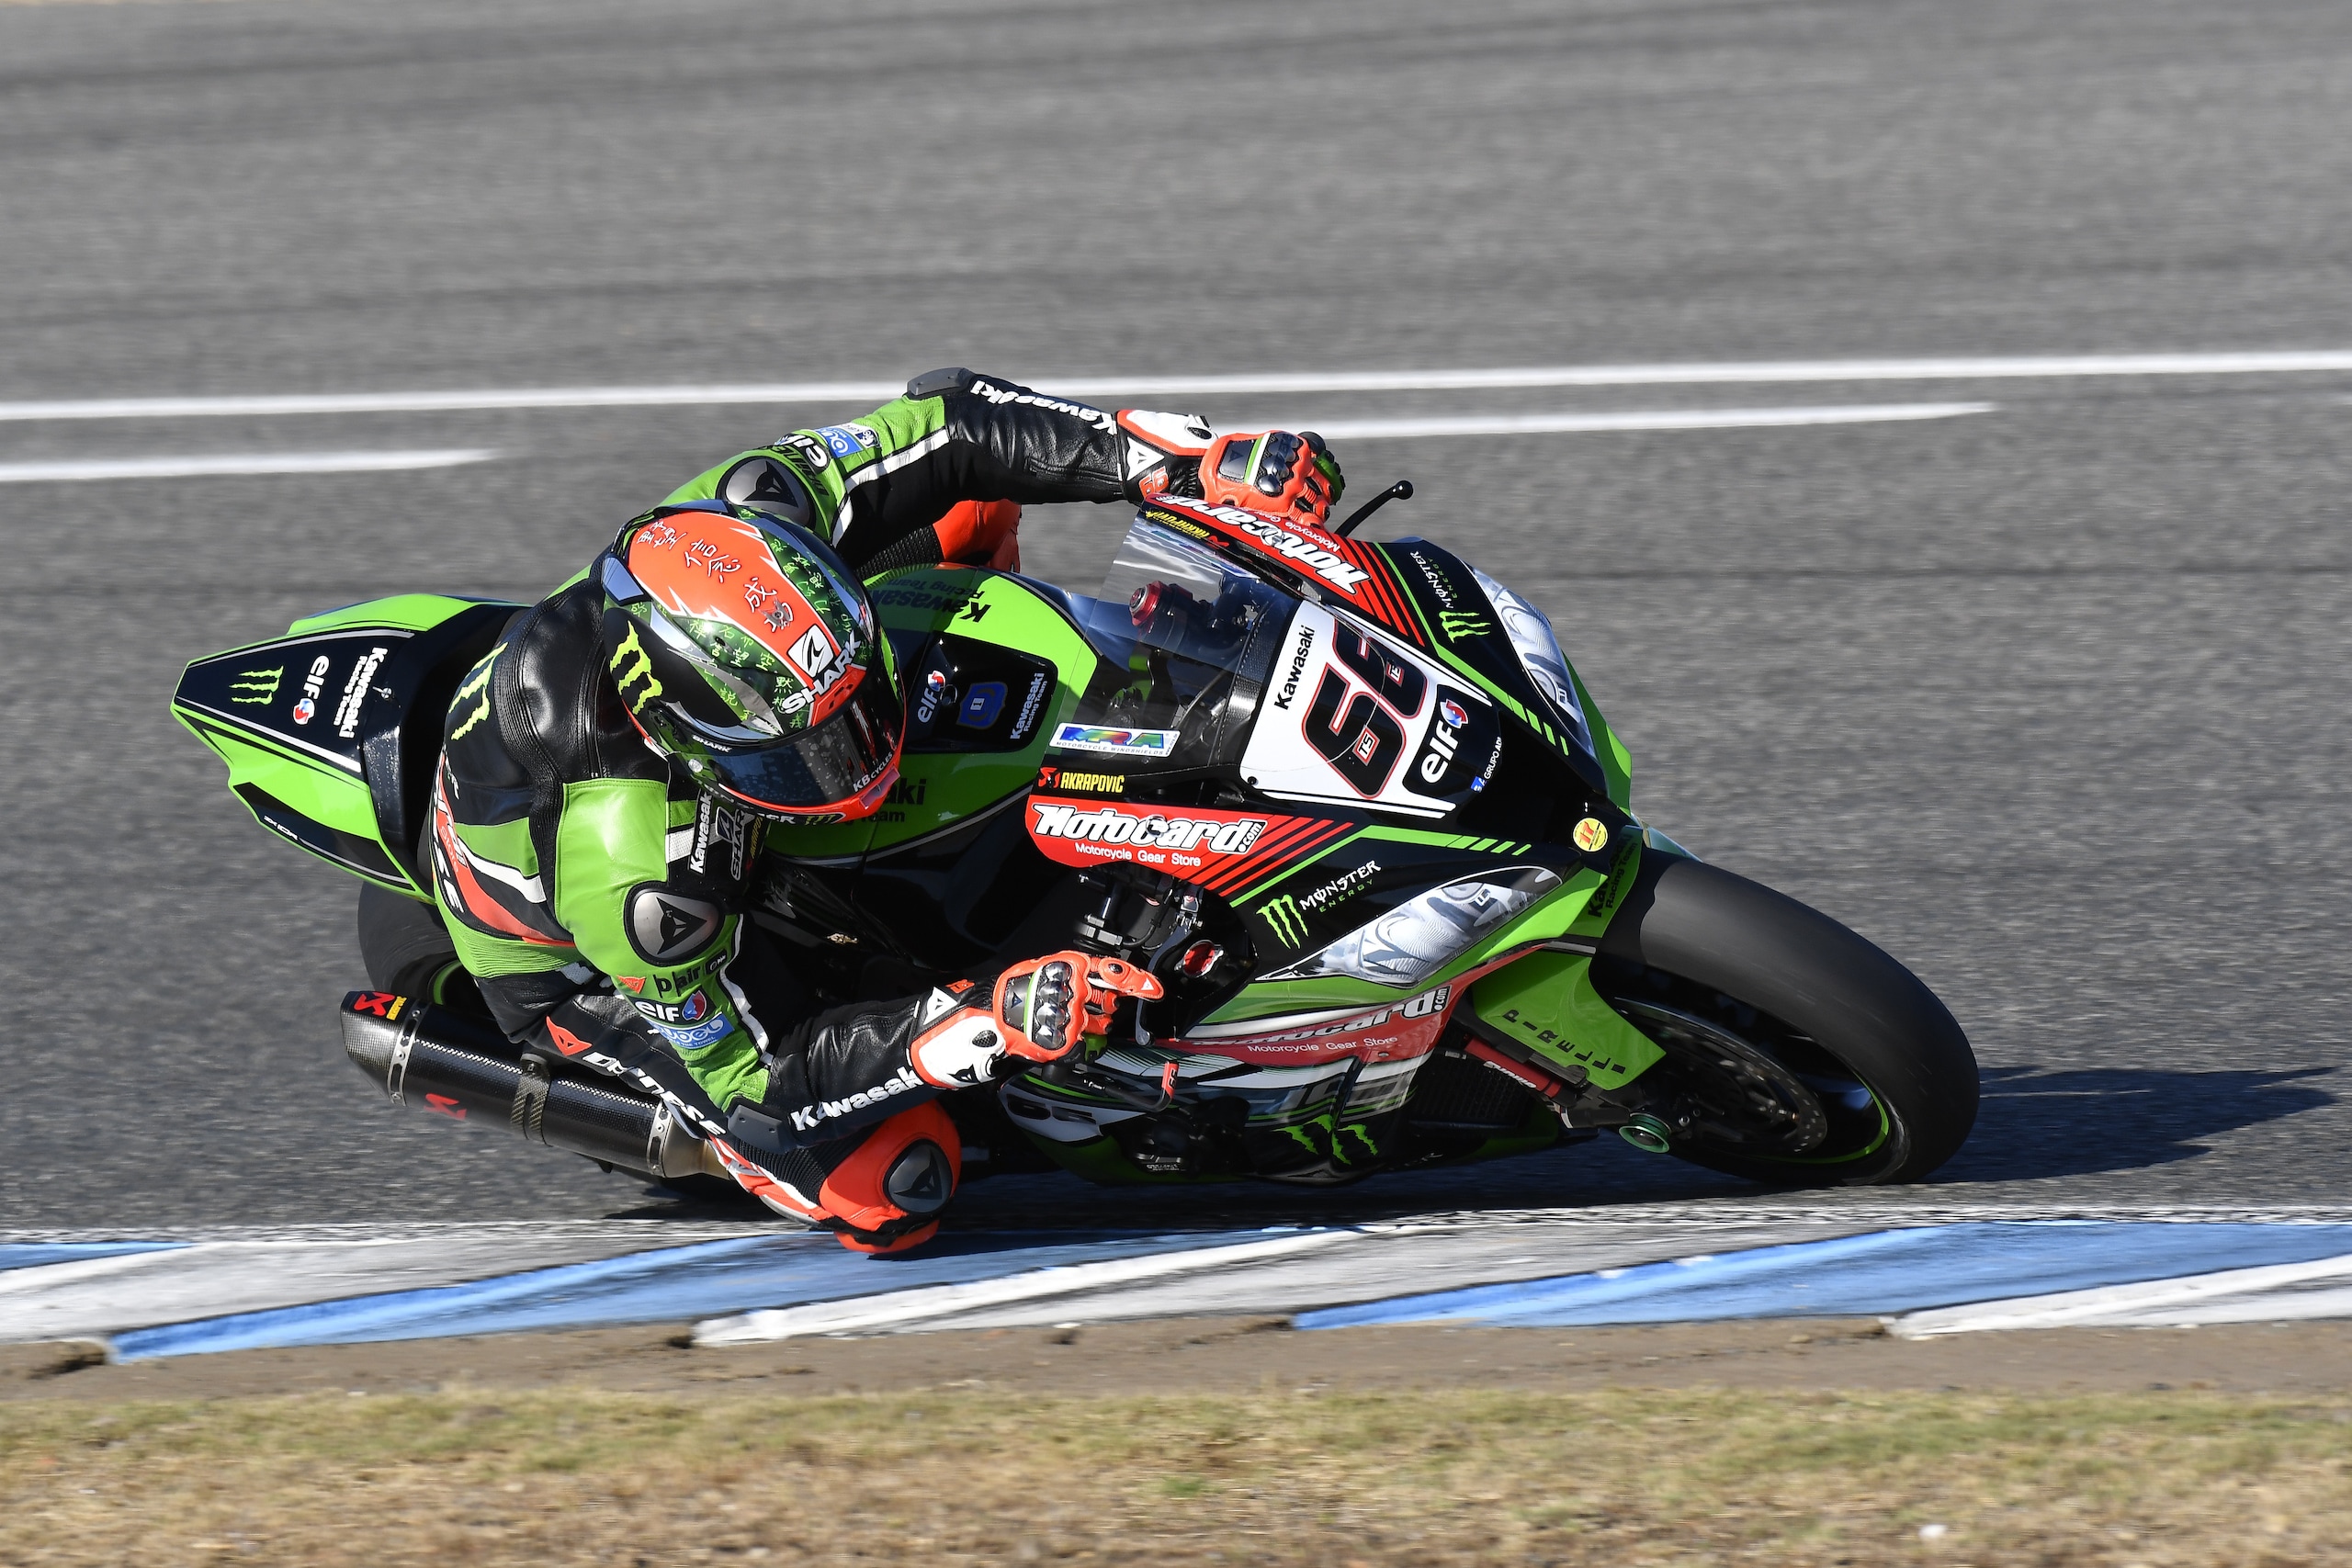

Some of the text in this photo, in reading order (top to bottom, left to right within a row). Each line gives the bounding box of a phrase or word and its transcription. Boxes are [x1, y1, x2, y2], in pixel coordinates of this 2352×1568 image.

[970, 379, 1117, 435] Kawasaki
[870, 590, 992, 624] Kawasak
[302, 655, 331, 700] elf
[781, 629, 863, 715] SHARK
[1273, 624, 1316, 710] Kawasaki
[338, 647, 389, 739] Kawasaki
[917, 687, 939, 724] elf
[1010, 672, 1046, 739] Kawasaki
[1023, 681, 1048, 732] Racing Team
[1301, 616, 1429, 800] 66
[692, 734, 733, 754] SHARK
[1056, 741, 1164, 756] MOTORCYCLE WINDSHIELDS
[1059, 726, 1165, 750] MRA
[1420, 718, 1463, 784] elf
[853, 773, 872, 793] KB
[870, 751, 893, 781] CYCLES
[1483, 750, 1500, 780] GRUPO
[690, 790, 713, 874] Kawasak
[731, 808, 746, 879] SHAR
[1075, 841, 1202, 867] Motorcycle Gear Store
[1319, 878, 1375, 914] ENERGY
[1605, 868, 1625, 909] Racing
[635, 1000, 680, 1022] elf
[1247, 1035, 1399, 1054] Motorcycle Gear Store
[789, 1065, 925, 1133] Kawasak
